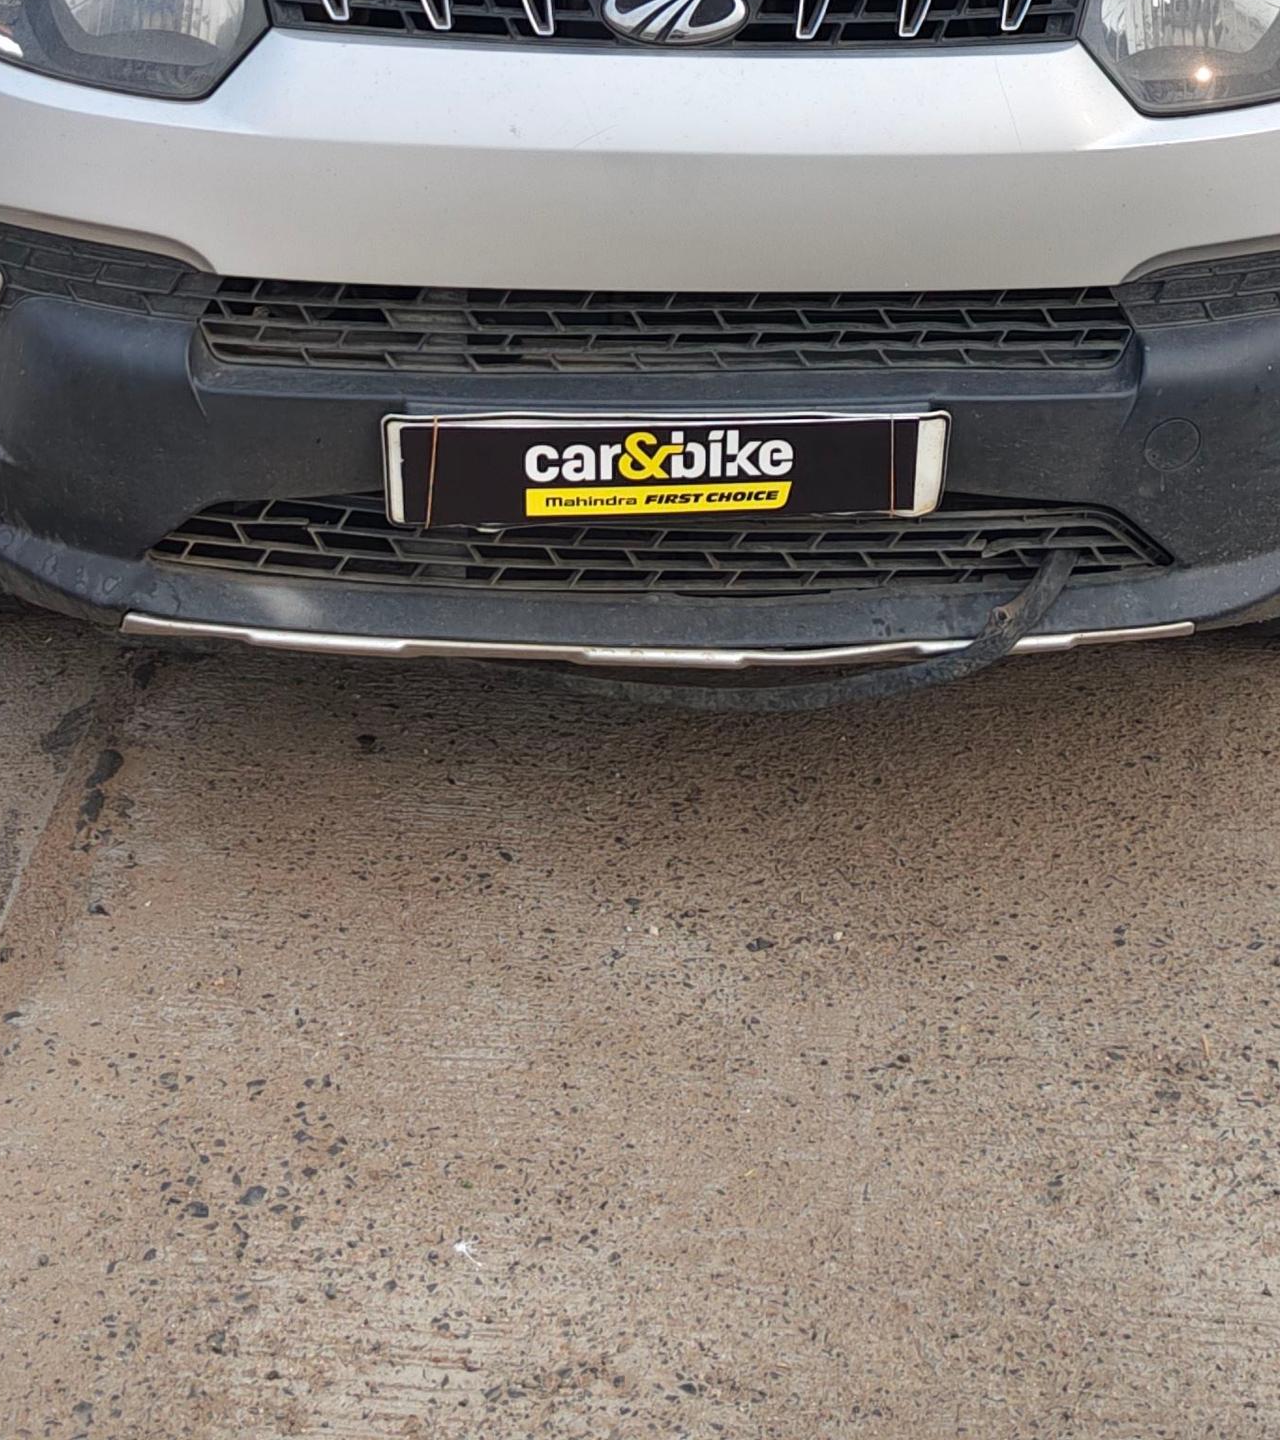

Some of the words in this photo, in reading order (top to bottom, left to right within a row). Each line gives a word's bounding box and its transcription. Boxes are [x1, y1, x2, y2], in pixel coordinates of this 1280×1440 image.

[525, 429, 794, 482] car&bike
[545, 495, 637, 507] Mahindra
[644, 493, 705, 505] FIRST
[706, 490, 779, 503] CHOICE
